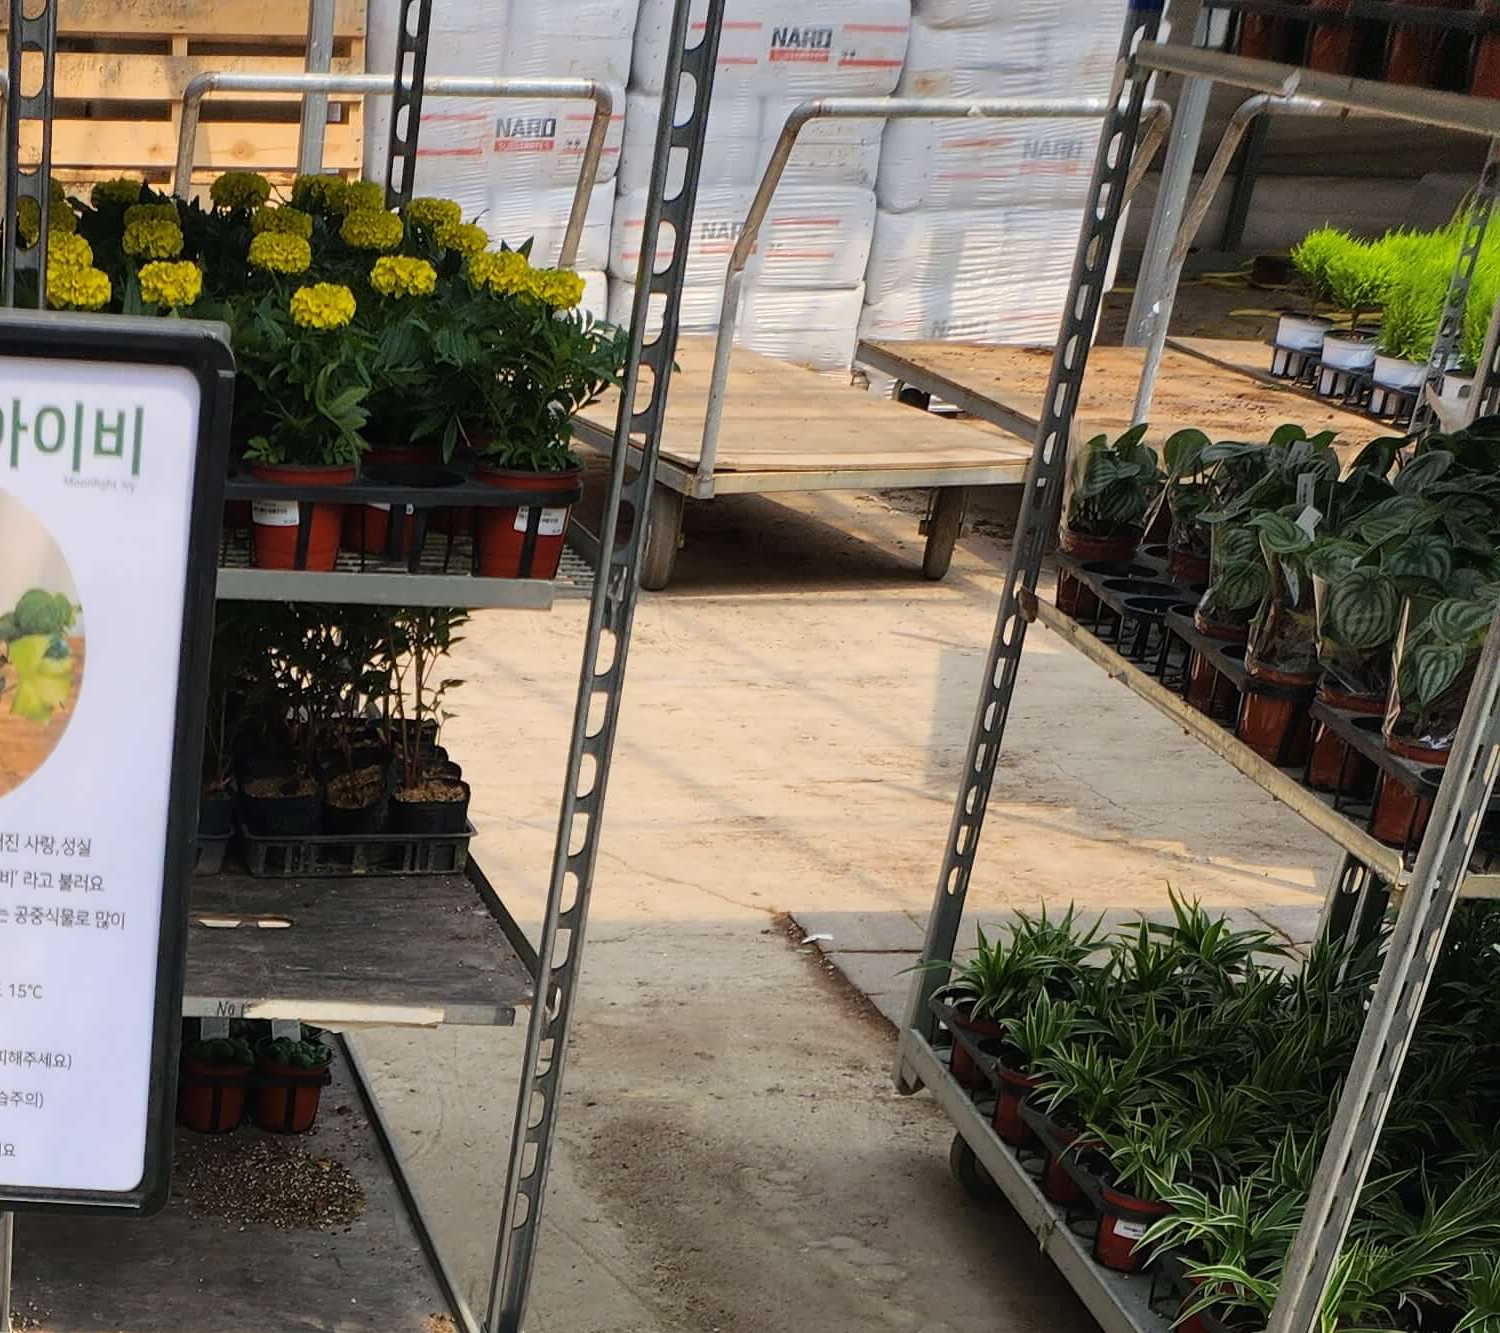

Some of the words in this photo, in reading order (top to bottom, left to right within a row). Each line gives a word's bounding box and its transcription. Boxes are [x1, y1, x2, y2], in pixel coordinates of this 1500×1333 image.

[24, 834, 92, 857] 사랑,성실
[23, 870, 54, 889] 라고
[59, 872, 105, 892] 불러요
[13, 904, 91, 927] 공중식물로
[95, 910, 126, 931] 많이
